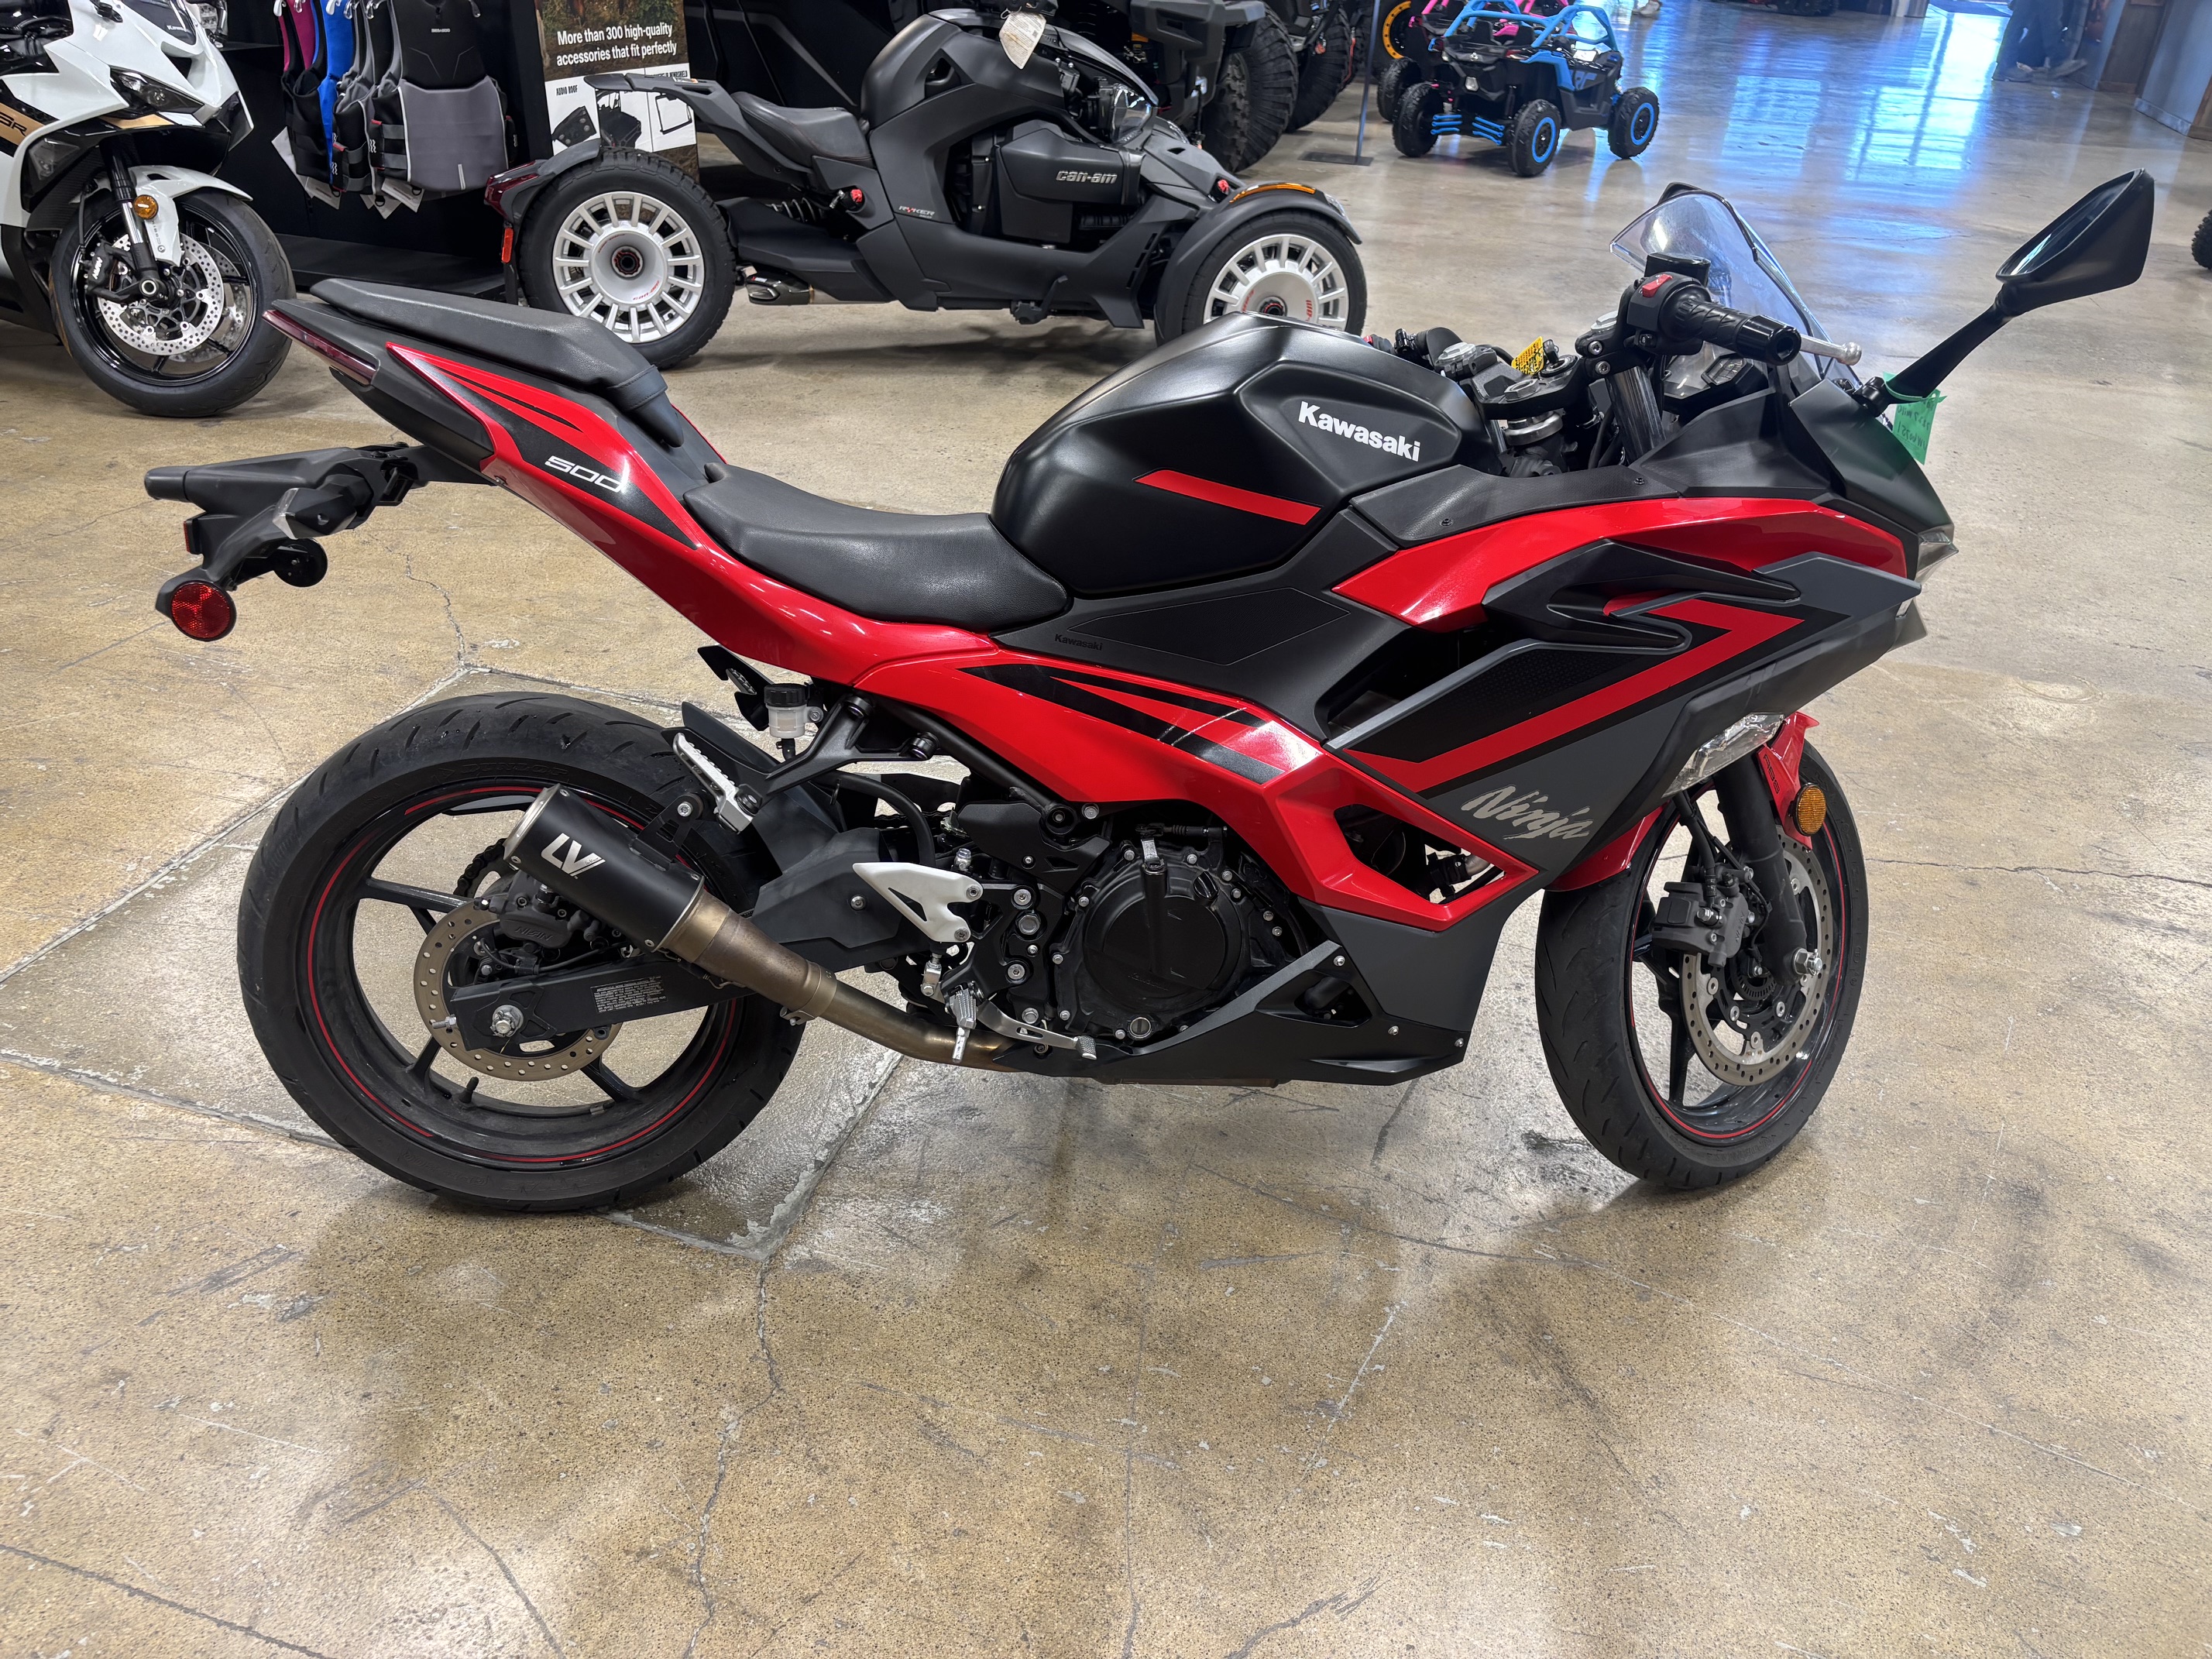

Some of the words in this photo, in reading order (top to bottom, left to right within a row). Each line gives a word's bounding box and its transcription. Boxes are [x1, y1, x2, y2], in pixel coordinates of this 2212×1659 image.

[557, 30, 582, 45] More
[583, 29, 605, 43] than
[606, 26, 623, 40] 300
[624, 22, 673, 40] high-quality
[556, 47, 611, 67] accessories
[611, 44, 630, 59] that
[630, 43, 641, 57] fit
[641, 40, 678, 60] perfectly
[1056, 170, 1118, 184] can-am
[1298, 400, 1421, 462] Kawasaki
[544, 455, 623, 493] 500
[1054, 634, 1104, 651] Kawasaki
[462, 762, 569, 775] DUNLOP
[1460, 784, 1595, 840] Ninja
[541, 833, 606, 877] LV
